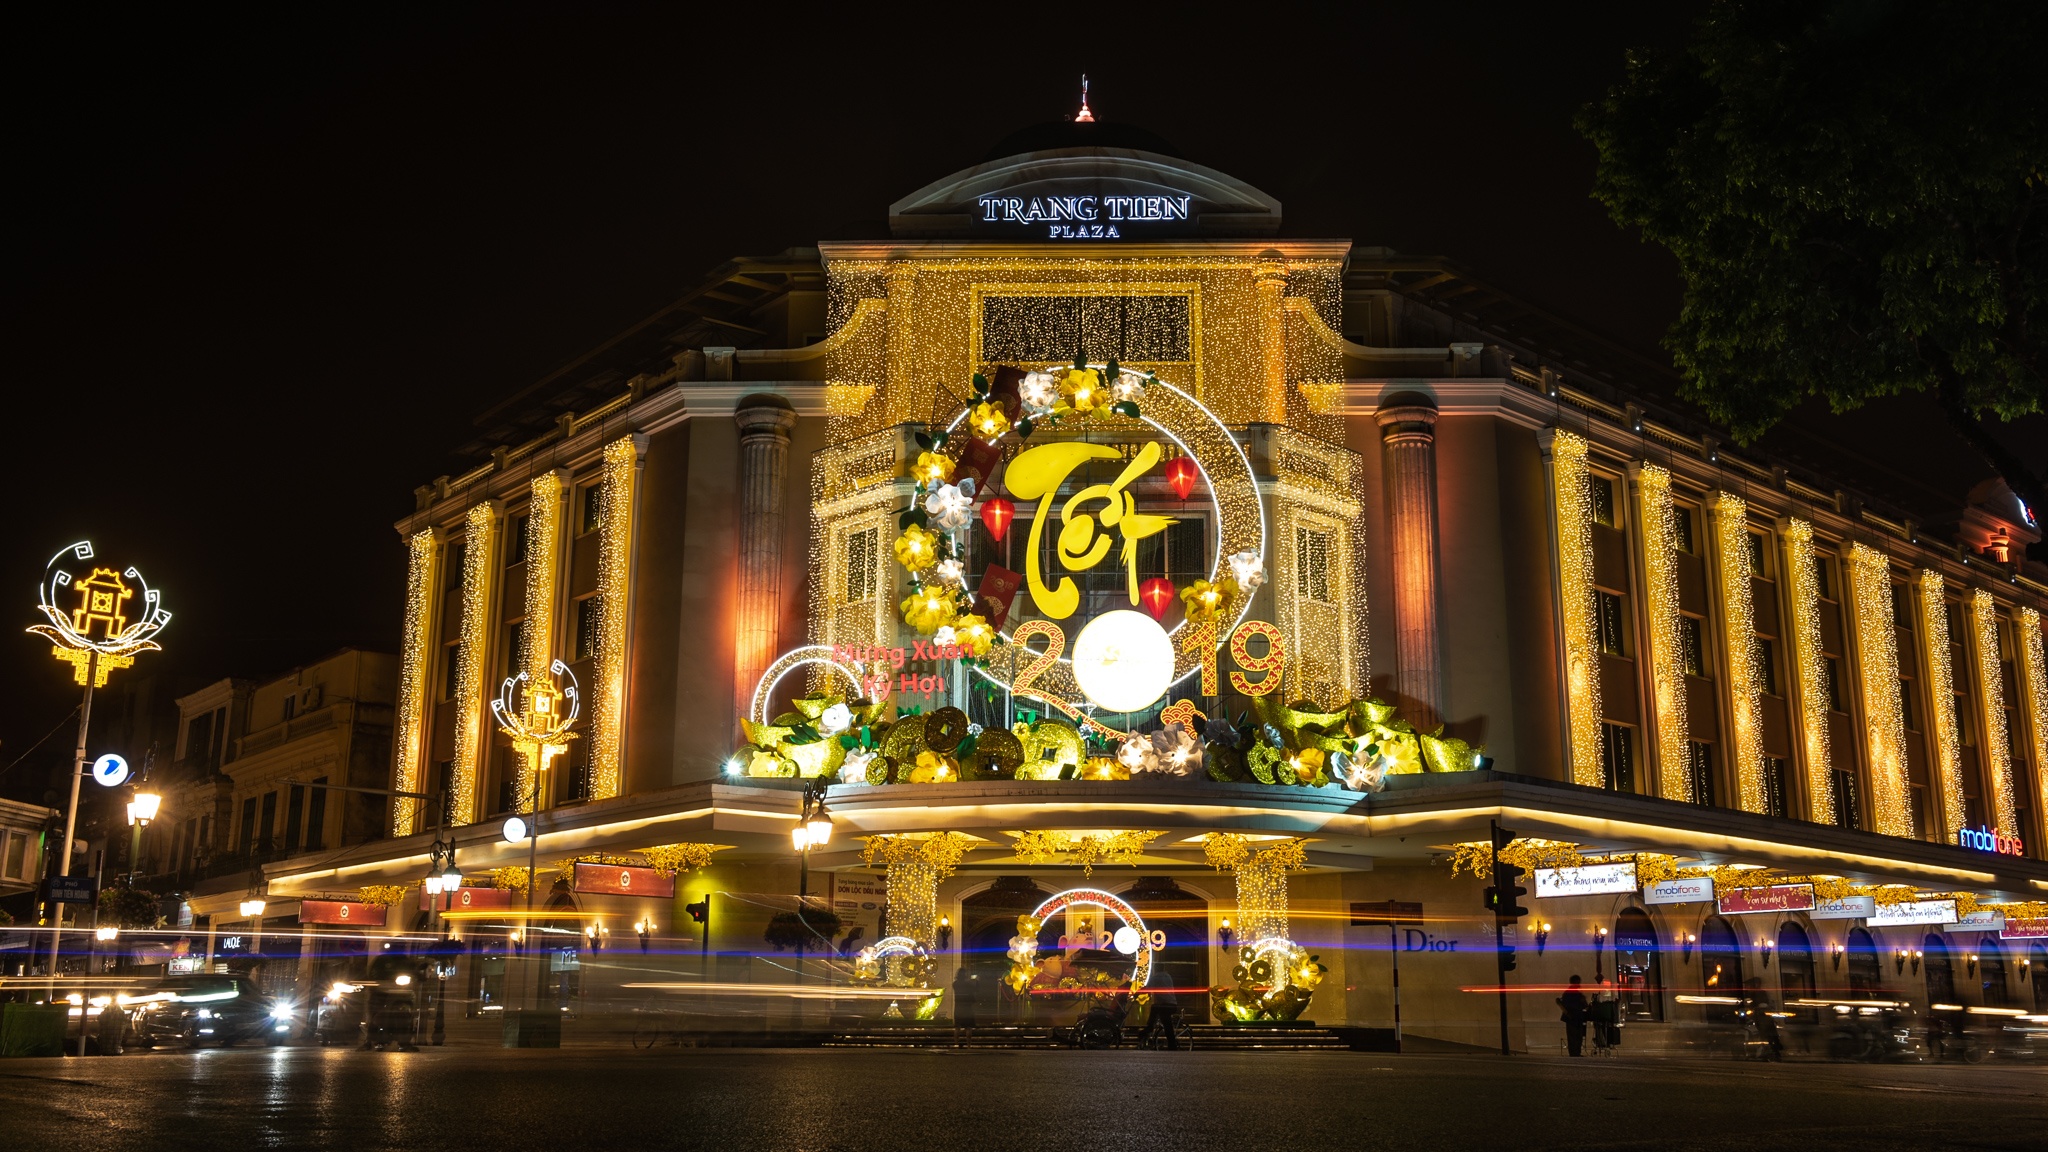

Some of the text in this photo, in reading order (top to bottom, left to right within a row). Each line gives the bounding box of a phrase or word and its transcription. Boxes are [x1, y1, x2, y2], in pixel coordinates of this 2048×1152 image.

[978, 195, 1190, 225] TRANG TIEN
[1049, 225, 1120, 238] PLAZA
[832, 639, 974, 669] Mừng Xuân
[863, 672, 945, 701] Kỷ Hợi
[1960, 825, 2023, 856] mobifone
[1655, 885, 1700, 895] mobifone
[1819, 902, 1863, 912] mobifone
[1403, 929, 1457, 952] Dior
